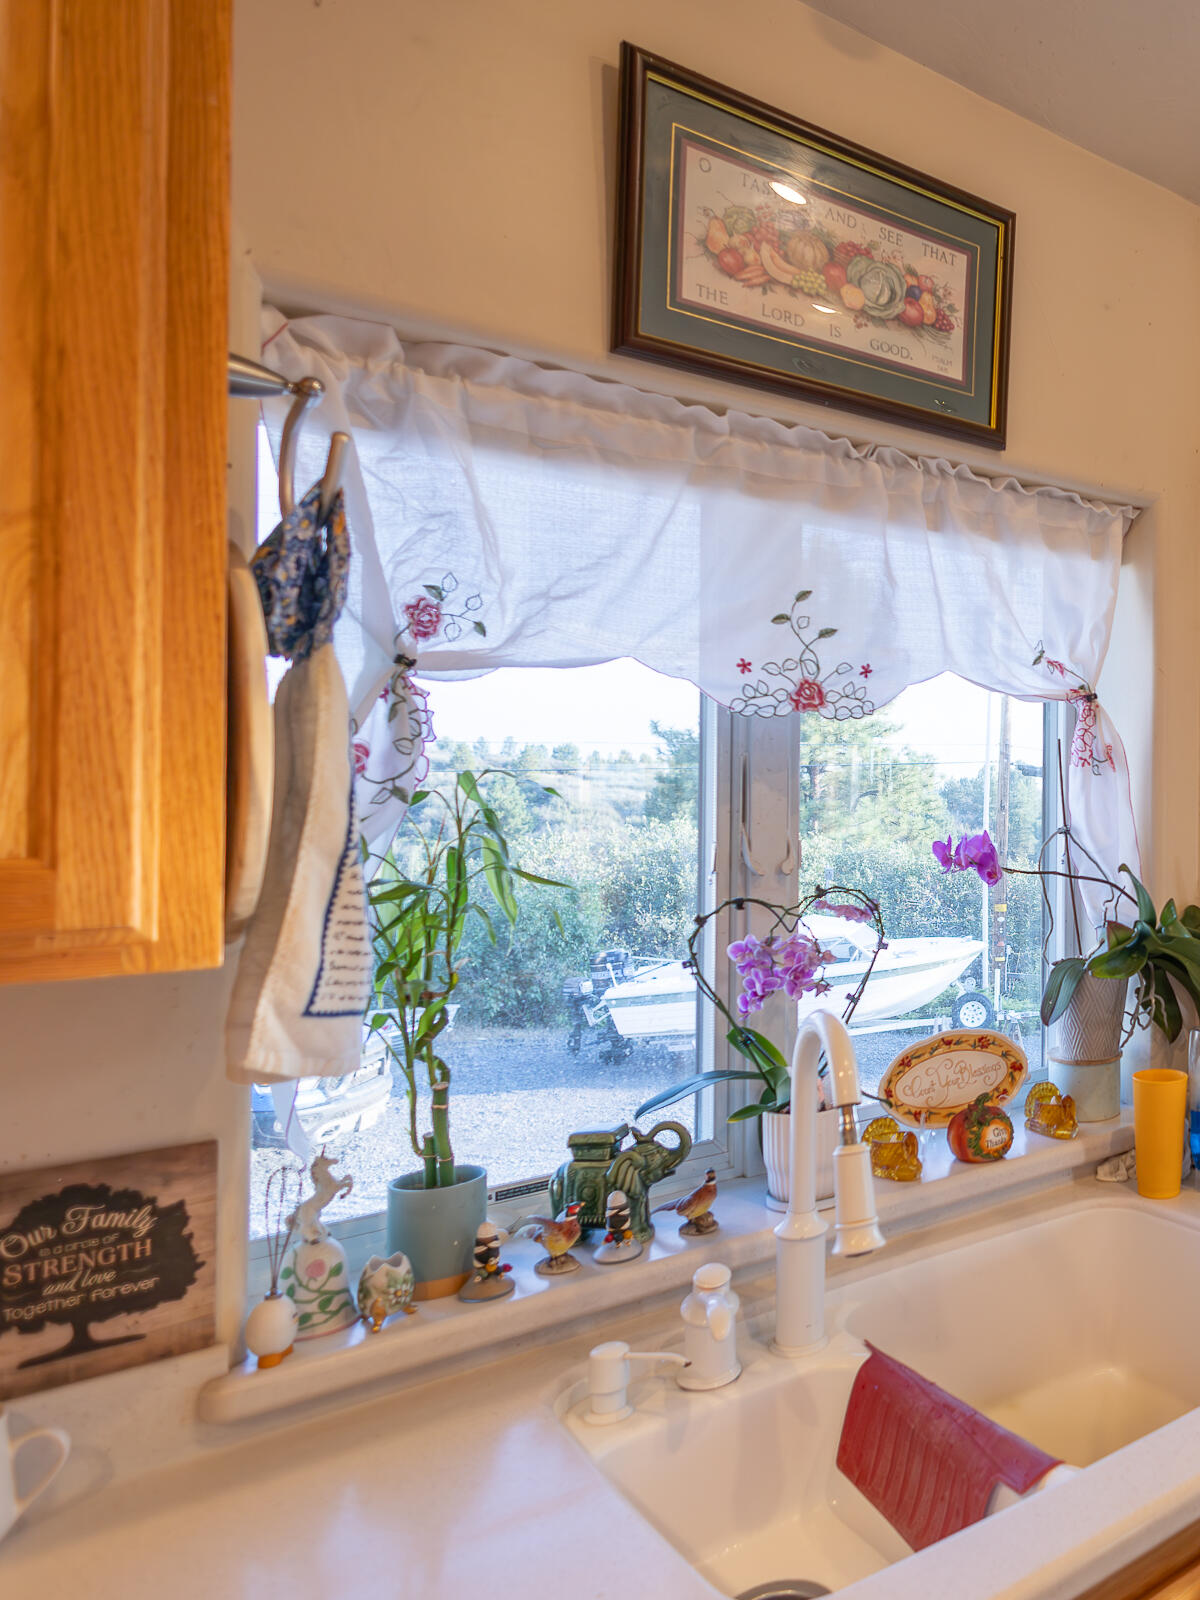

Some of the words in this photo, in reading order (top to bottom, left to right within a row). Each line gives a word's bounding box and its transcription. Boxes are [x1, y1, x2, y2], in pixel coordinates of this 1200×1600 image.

[699, 157, 712, 173] O
[825, 207, 857, 229] AND
[878, 227, 904, 247] SEE
[921, 242, 957, 267] THAT
[696, 283, 729, 306] THE
[761, 303, 805, 328] LORD
[829, 323, 842, 339] IS
[869, 338, 914, 361] GOOD.
[0, 1226, 58, 1258] Our
[62, 1204, 158, 1238] Family
[2, 1238, 153, 1286] STRENGTH
[42, 1270, 83, 1296] and
[81, 1269, 117, 1288] love
[4, 1294, 85, 1322] Together
